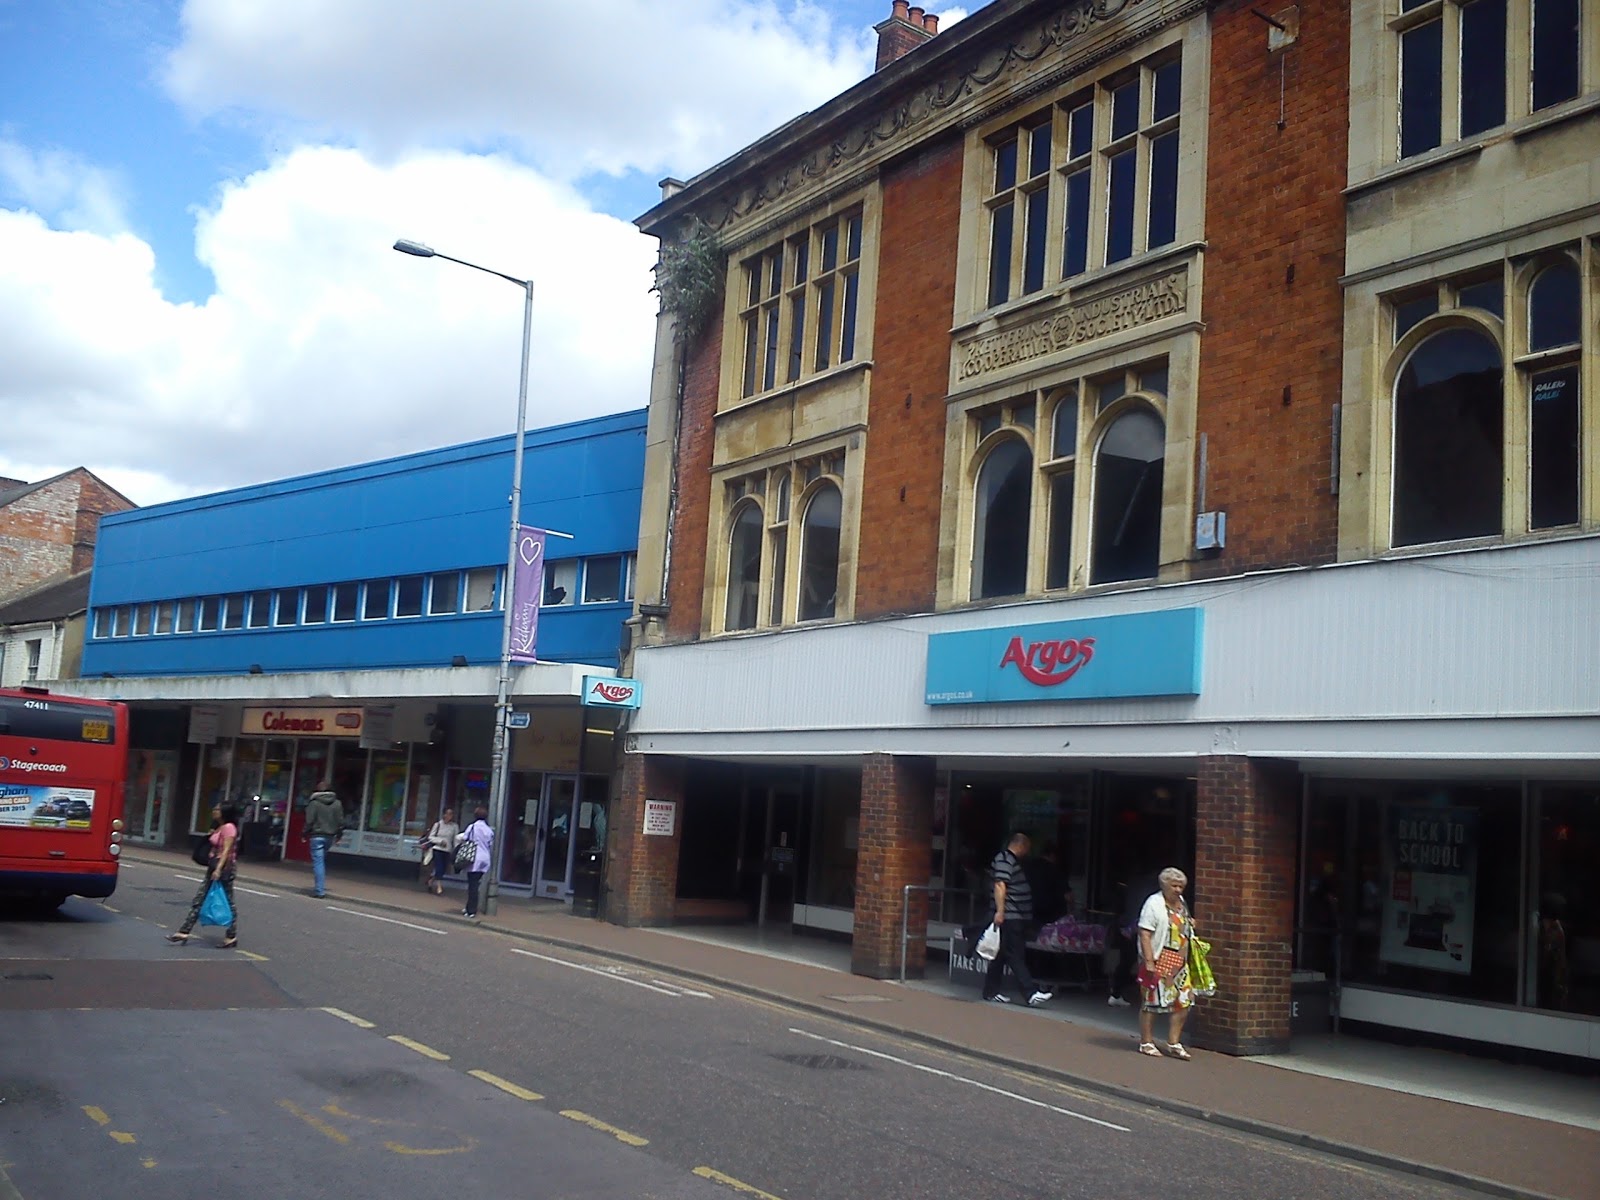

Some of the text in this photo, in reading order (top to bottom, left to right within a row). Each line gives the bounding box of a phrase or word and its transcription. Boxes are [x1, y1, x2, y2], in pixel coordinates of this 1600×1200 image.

[515, 602, 538, 654] Kettering
[1000, 636, 1096, 687] Argos
[591, 682, 634, 702] Argos
[24, 701, 48, 710] 47411
[263, 711, 324, 731] Colemans
[11, 760, 67, 772] Stagecoach
[1398, 819, 1464, 844] BACK TO
[1399, 843, 1461, 868] SCHOOL
[953, 953, 974, 971] TAKE
